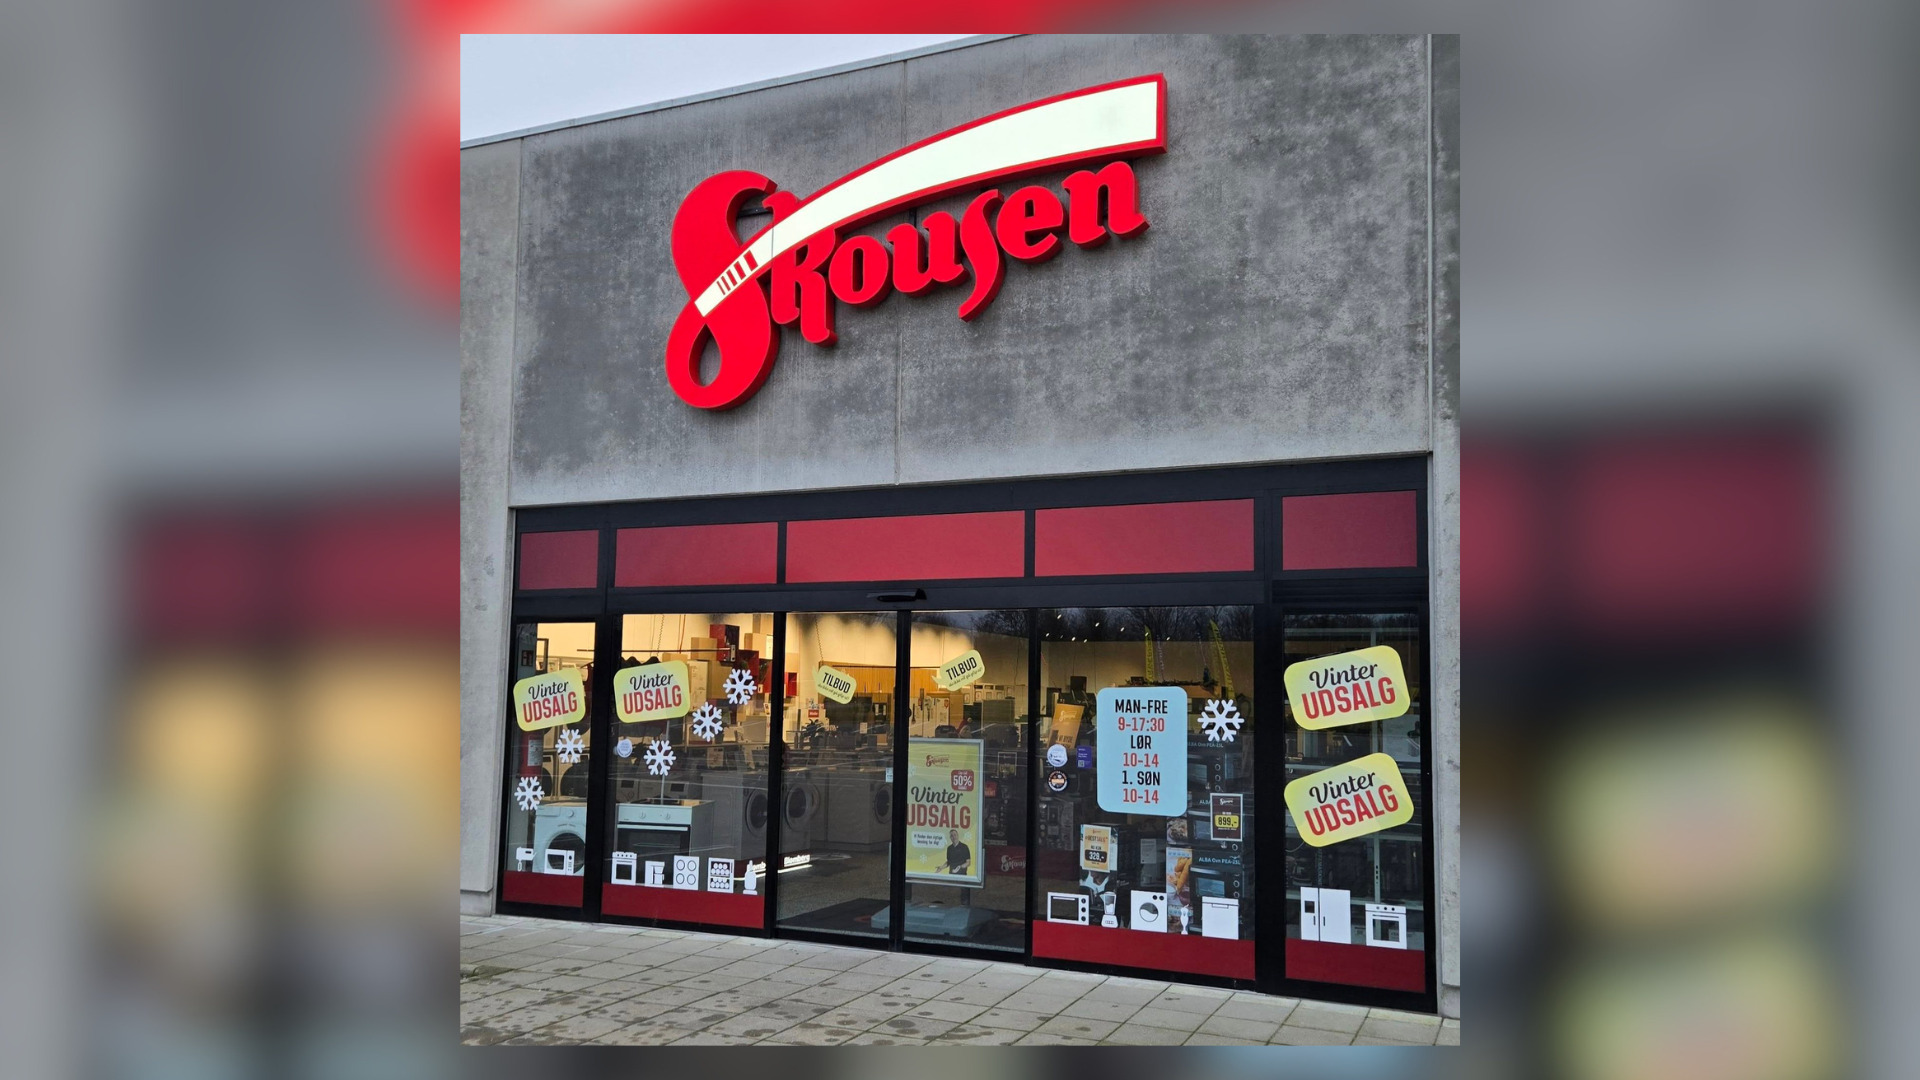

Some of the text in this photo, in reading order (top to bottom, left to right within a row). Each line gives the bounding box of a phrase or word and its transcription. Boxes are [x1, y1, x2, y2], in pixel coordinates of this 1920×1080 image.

[665, 160, 1152, 411] Skousen
[945, 657, 977, 681] TILBUD
[1309, 663, 1378, 689] Vinter
[528, 681, 569, 700] Vinter
[629, 673, 674, 691] Vinter
[822, 672, 851, 694] TILBUD
[523, 691, 578, 723] UDSALG
[623, 685, 682, 715] UDSALG
[1115, 699, 1168, 714] MAN-FRE
[1301, 676, 1397, 720] UDSALG
[1118, 716, 1165, 732] 9-17:30
[1130, 735, 1152, 749] LØR
[1123, 752, 1159, 767] 10-14
[953, 775, 972, 786] 50%
[1122, 770, 1160, 786] 1. SØN
[911, 786, 963, 804] Vinter
[1123, 788, 1159, 804] 10-14
[1309, 772, 1375, 804] Vinter
[907, 804, 971, 829] UDSALG
[1305, 784, 1399, 836] UDSALG
[1218, 816, 1237, 827] 899,-
